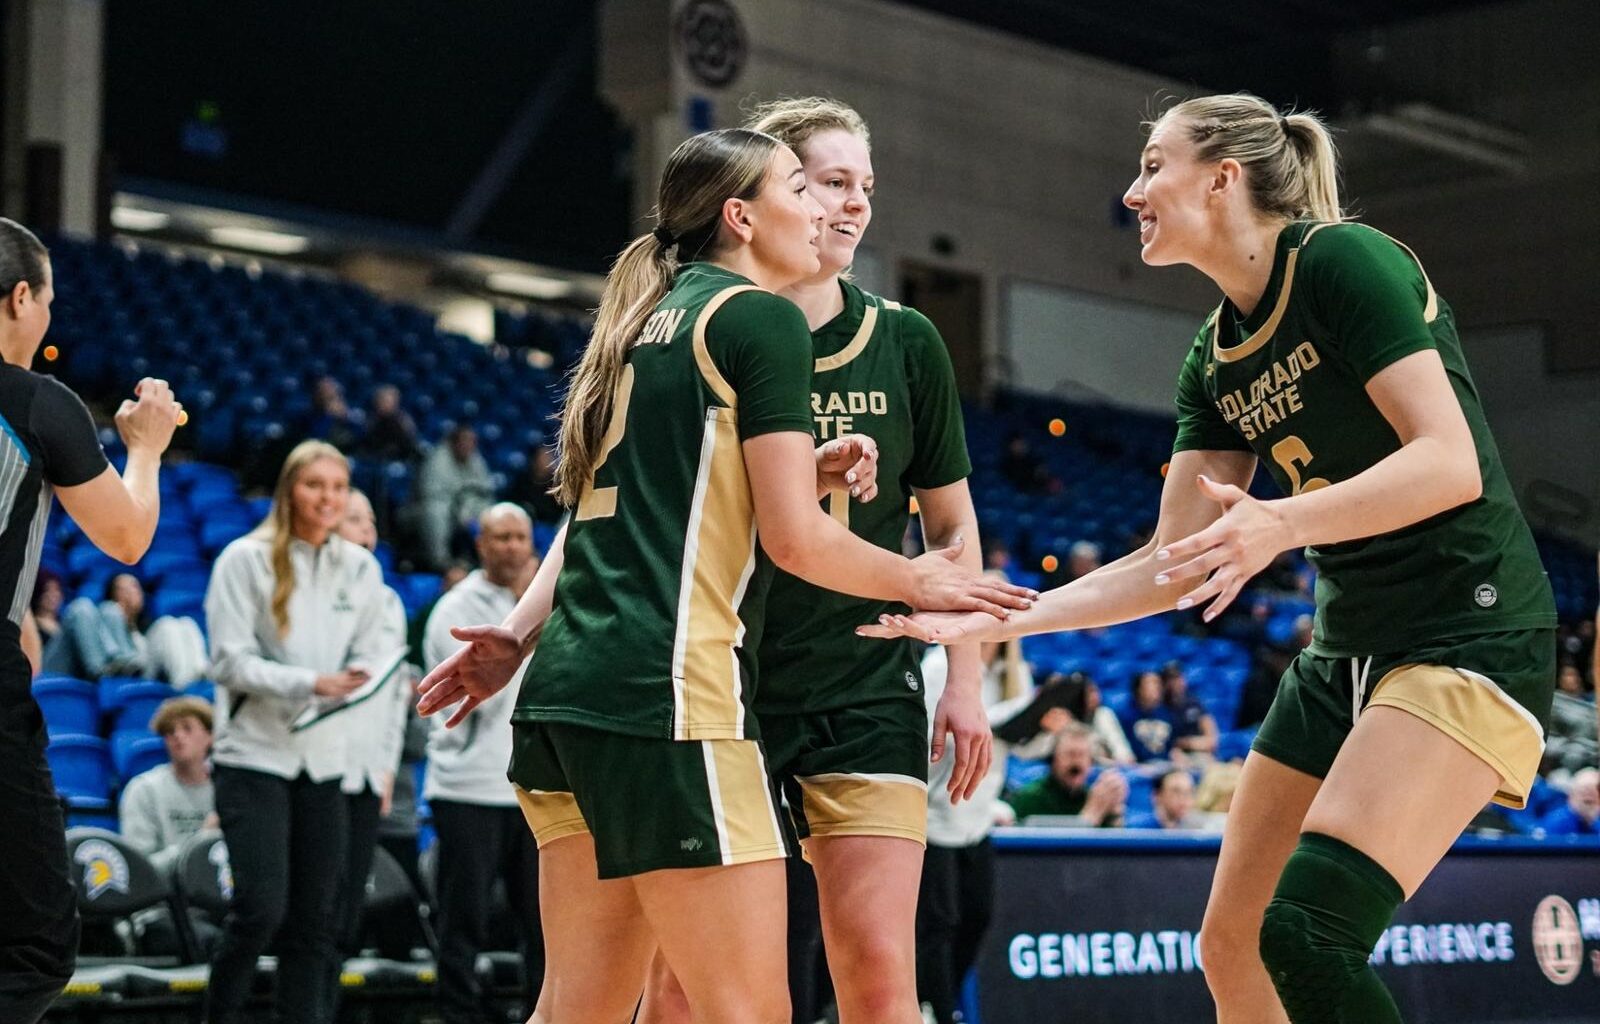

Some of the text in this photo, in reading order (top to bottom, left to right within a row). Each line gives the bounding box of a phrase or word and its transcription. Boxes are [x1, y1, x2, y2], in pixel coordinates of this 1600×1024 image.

[812, 416, 853, 440] TE
[1239, 384, 1304, 441] STATE
[575, 362, 634, 521] 2
[1008, 921, 1514, 979] GENERATI PERIENCE
